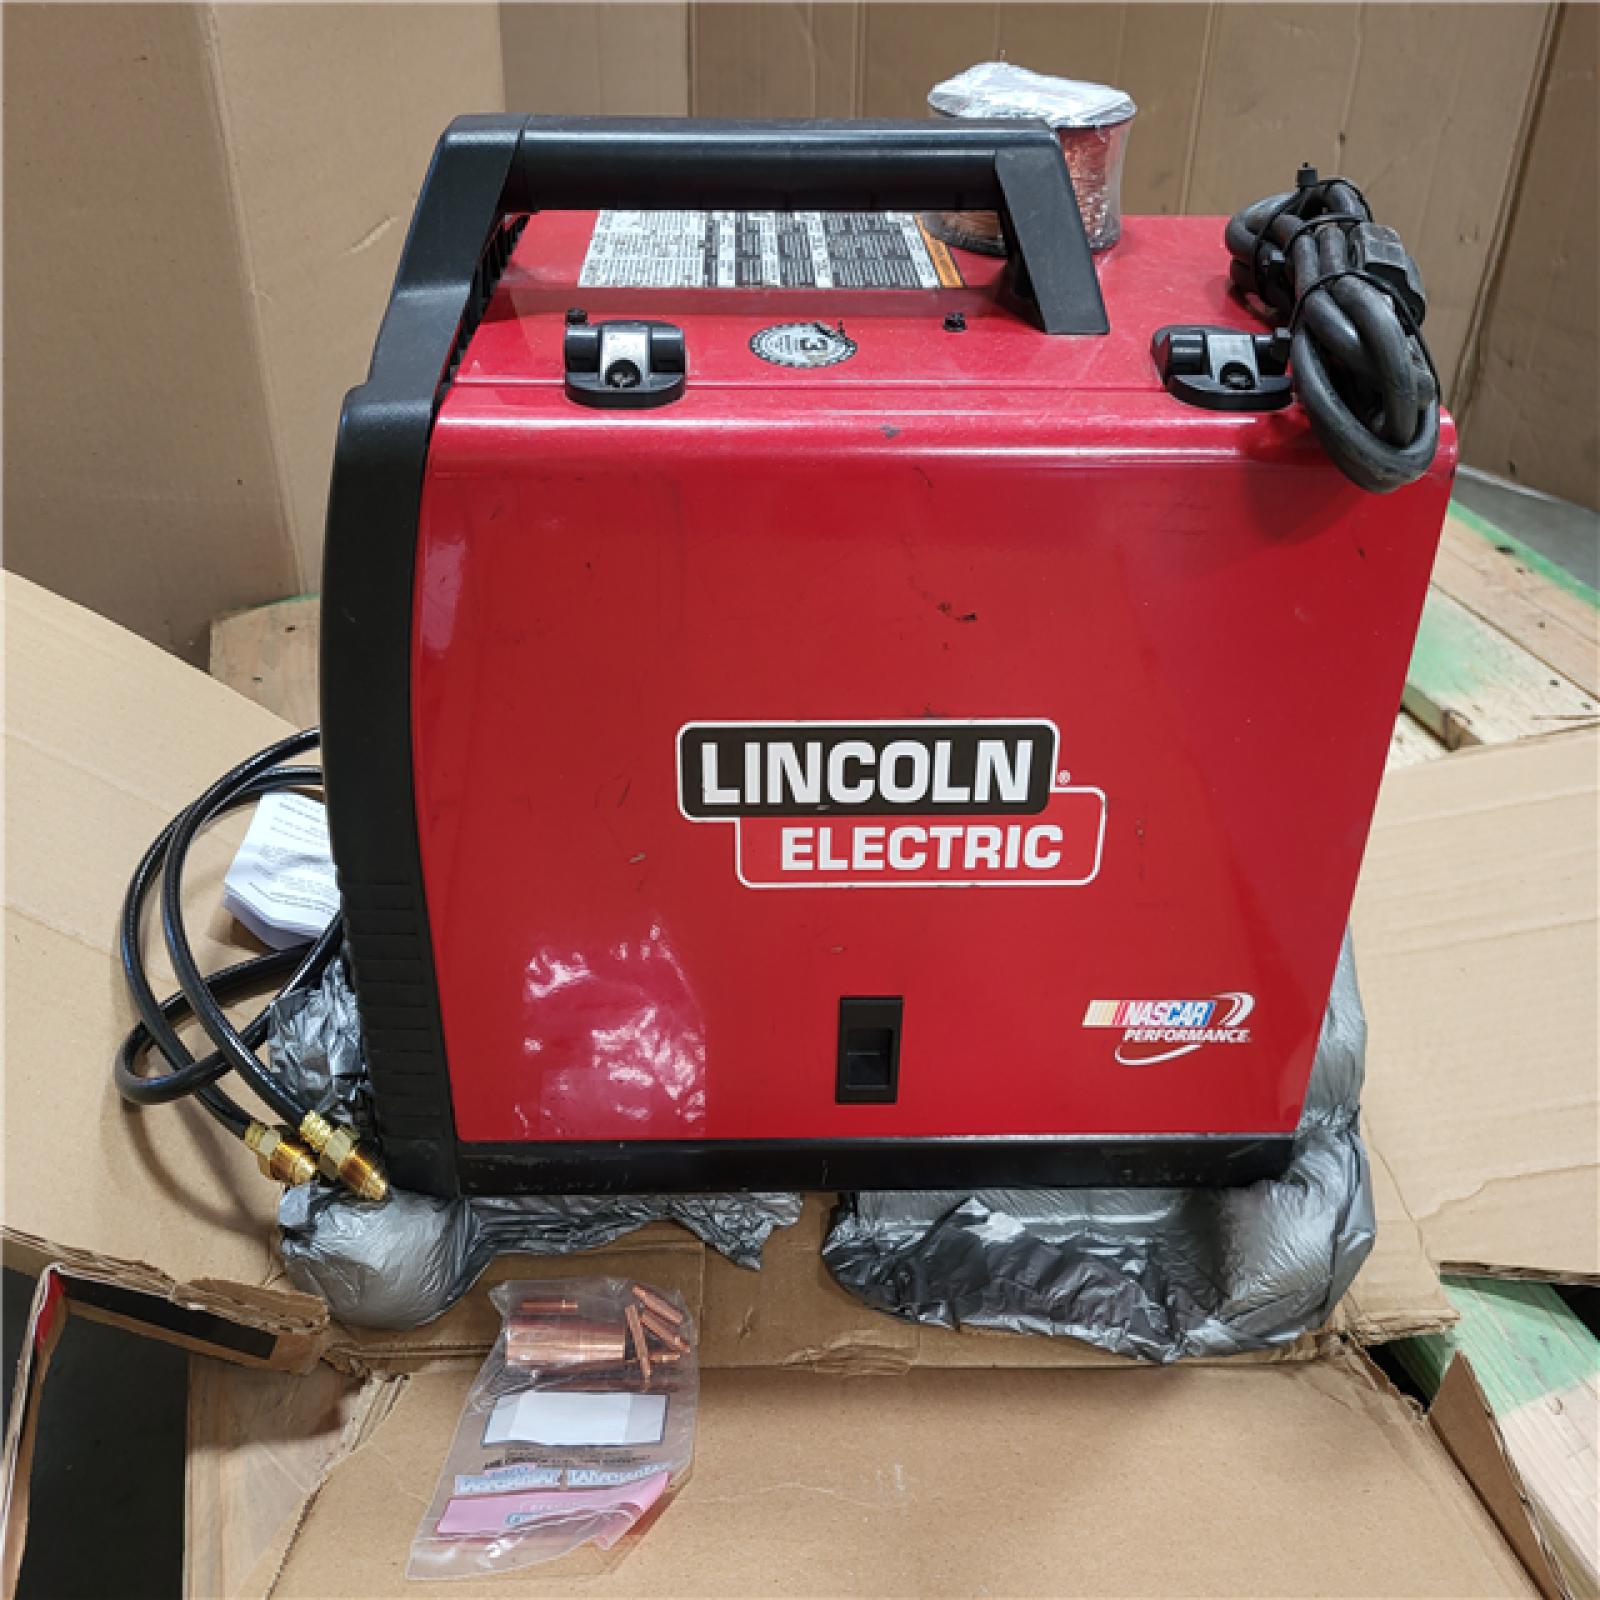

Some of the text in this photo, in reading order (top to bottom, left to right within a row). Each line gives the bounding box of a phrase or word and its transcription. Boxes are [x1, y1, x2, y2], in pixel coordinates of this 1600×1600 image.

[701, 740, 1033, 804] LINCOLN
[781, 825, 1064, 871] ELECTRIC
[1125, 1001, 1209, 1026] NASCAR
[1123, 1029, 1249, 1042] PERFORMANCE
